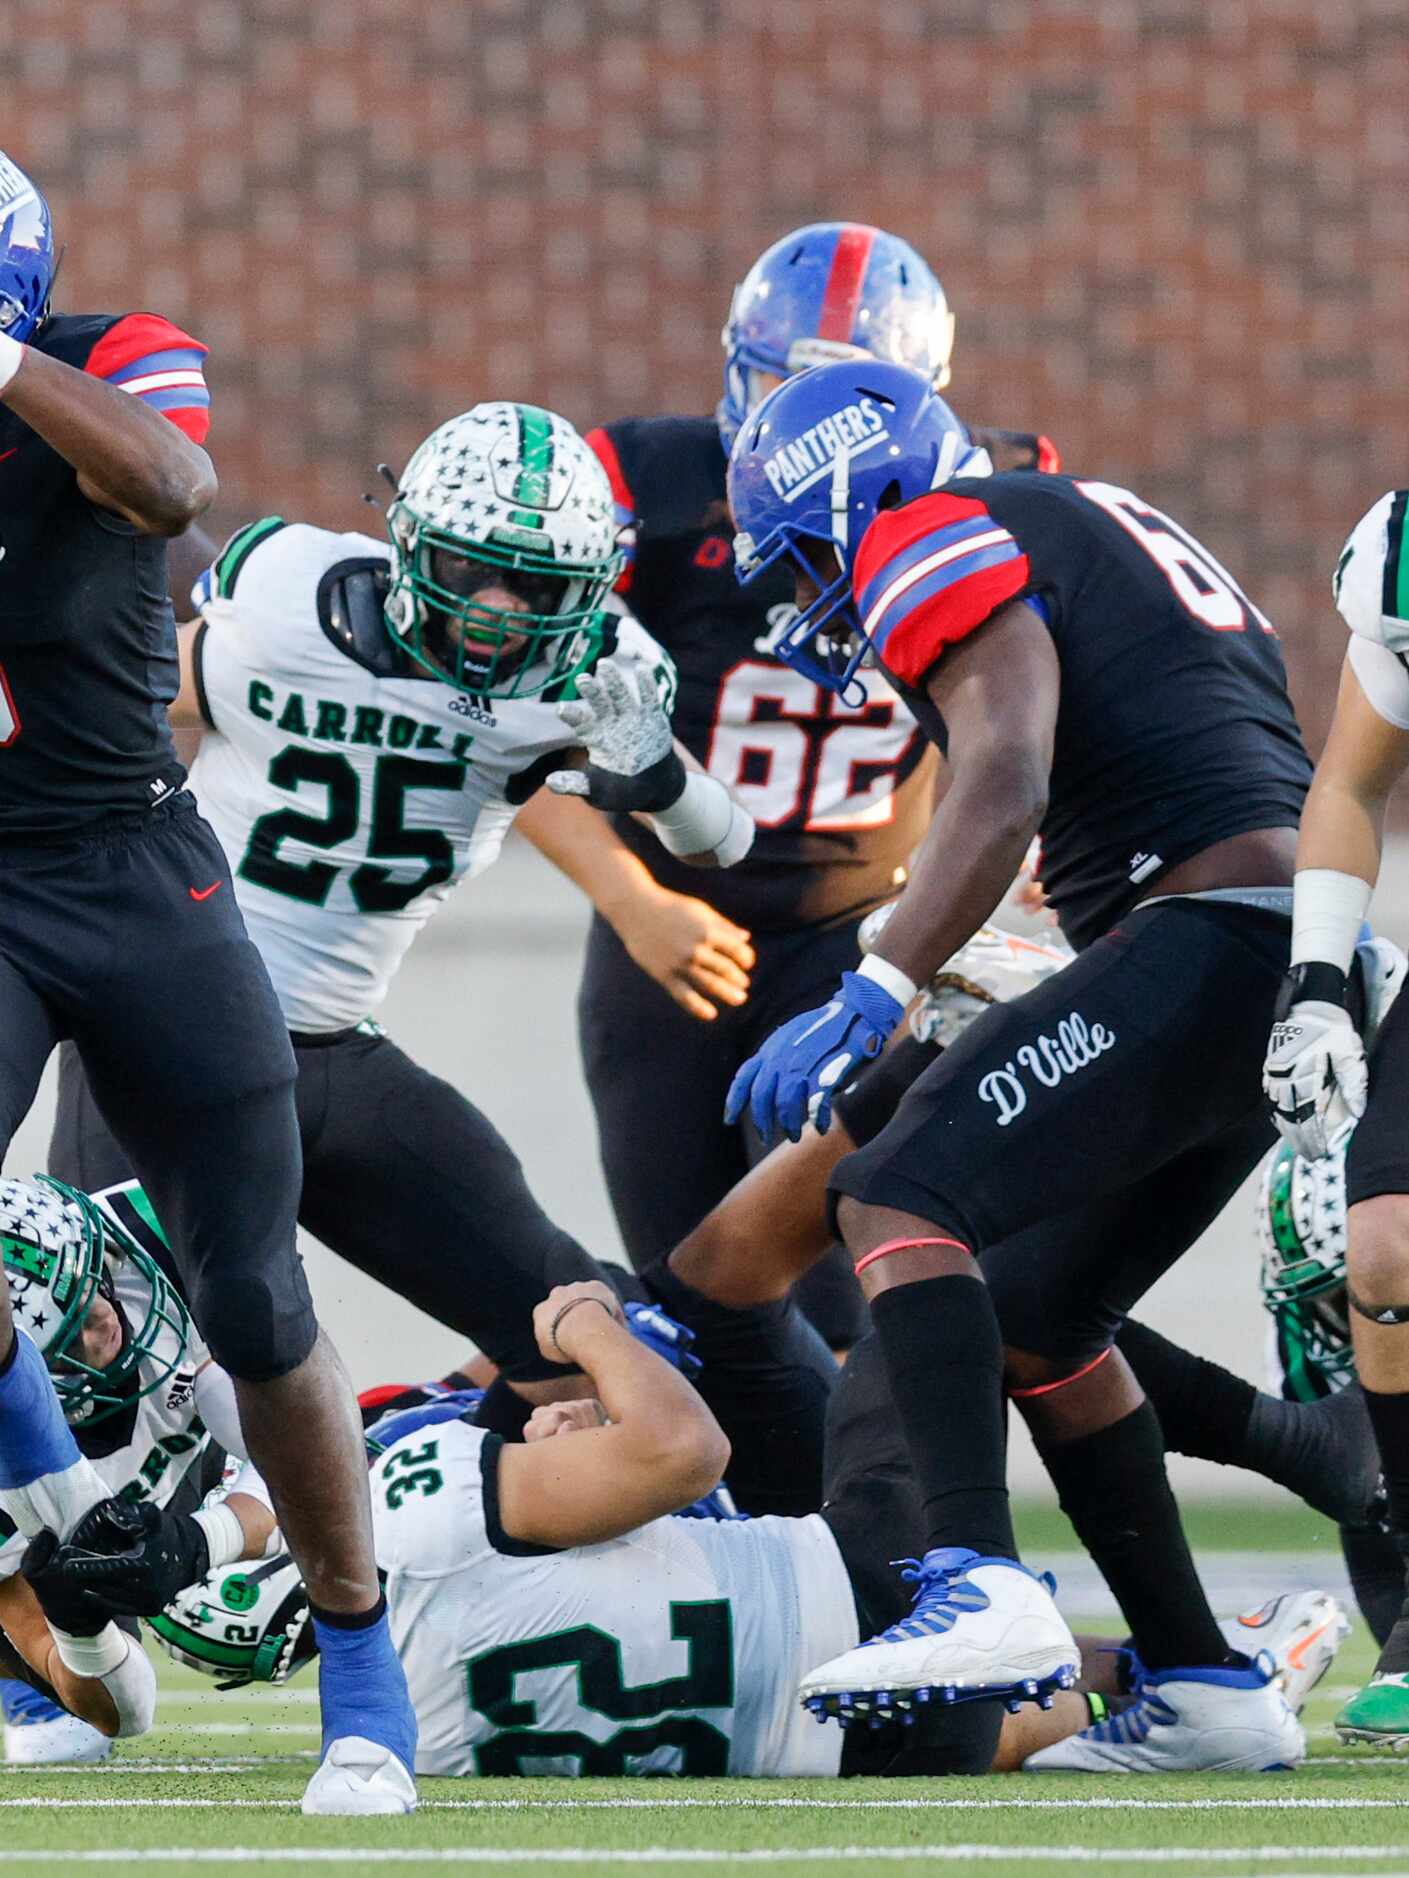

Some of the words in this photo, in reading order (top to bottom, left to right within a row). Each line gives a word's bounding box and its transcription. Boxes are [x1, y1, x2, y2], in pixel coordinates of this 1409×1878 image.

[763, 398, 884, 497] PANTHERS
[704, 658, 920, 833] 62
[235, 743, 468, 913] 25
[977, 1011, 1117, 1127] D'Ville
[382, 1439, 445, 1512] 32
